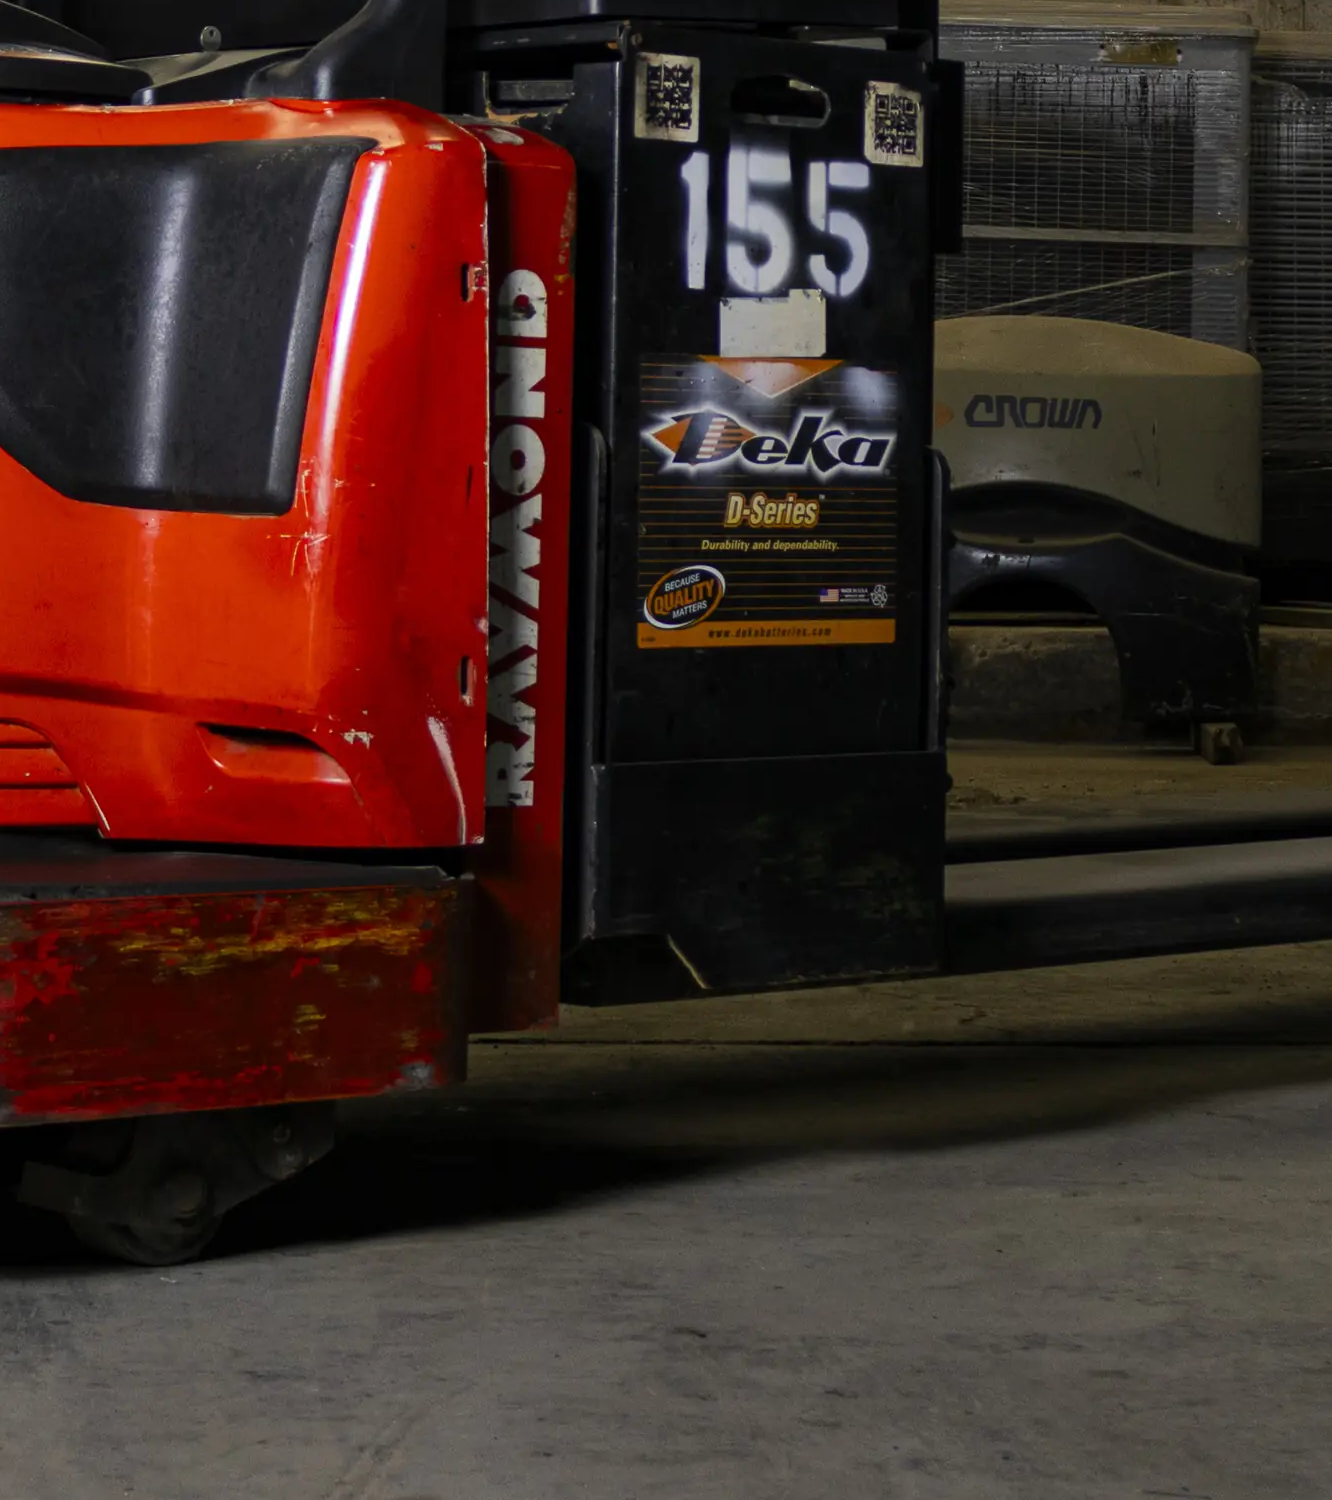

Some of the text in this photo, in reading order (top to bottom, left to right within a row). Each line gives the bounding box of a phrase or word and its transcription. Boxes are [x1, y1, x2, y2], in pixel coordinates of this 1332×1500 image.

[680, 143, 870, 298] 155
[652, 408, 891, 474] Deka
[724, 491, 820, 528] D-Series
[485, 269, 548, 807] RAYMOND
[701, 539, 840, 552] Durability and dependability.
[653, 578, 715, 616] QUALITY
[664, 572, 701, 592] BECAUSE
[672, 600, 708, 619] MATTERS
